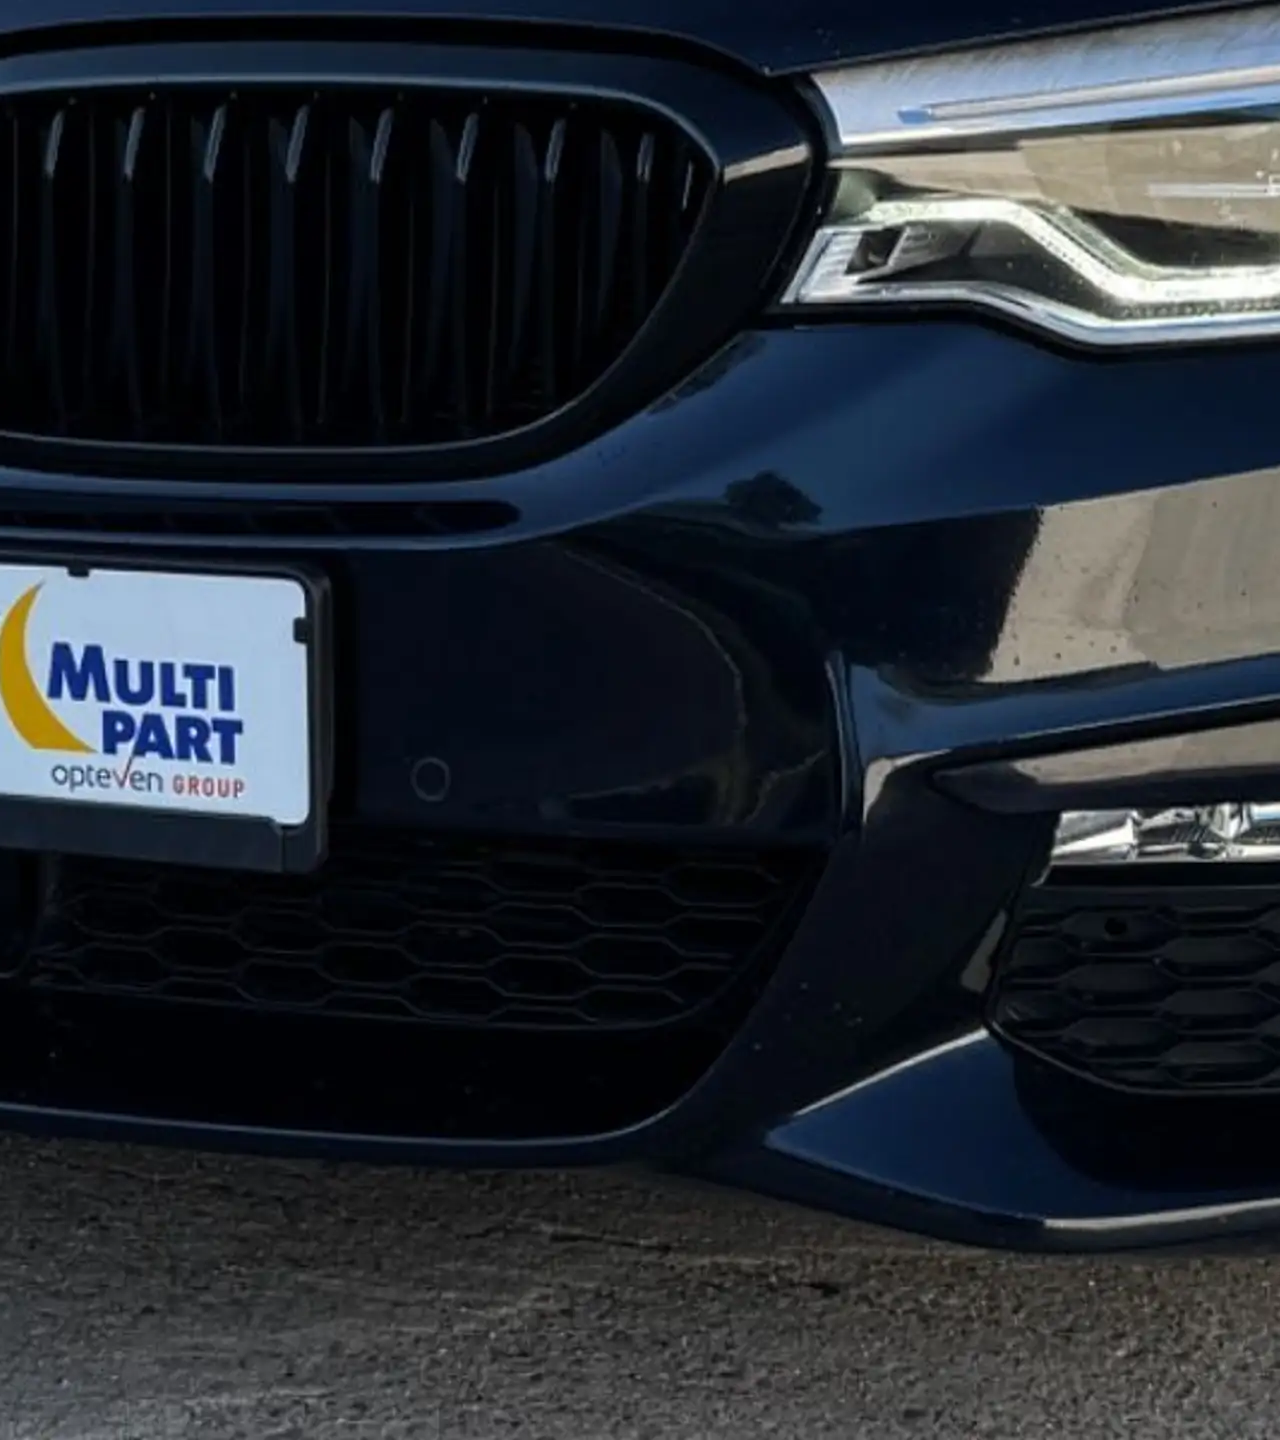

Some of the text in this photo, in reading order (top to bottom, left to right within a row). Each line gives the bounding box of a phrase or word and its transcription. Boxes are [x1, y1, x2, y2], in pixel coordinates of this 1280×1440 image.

[47, 641, 235, 712] MULTI
[102, 709, 244, 766] PART
[50, 752, 245, 799] opteven GROUP
